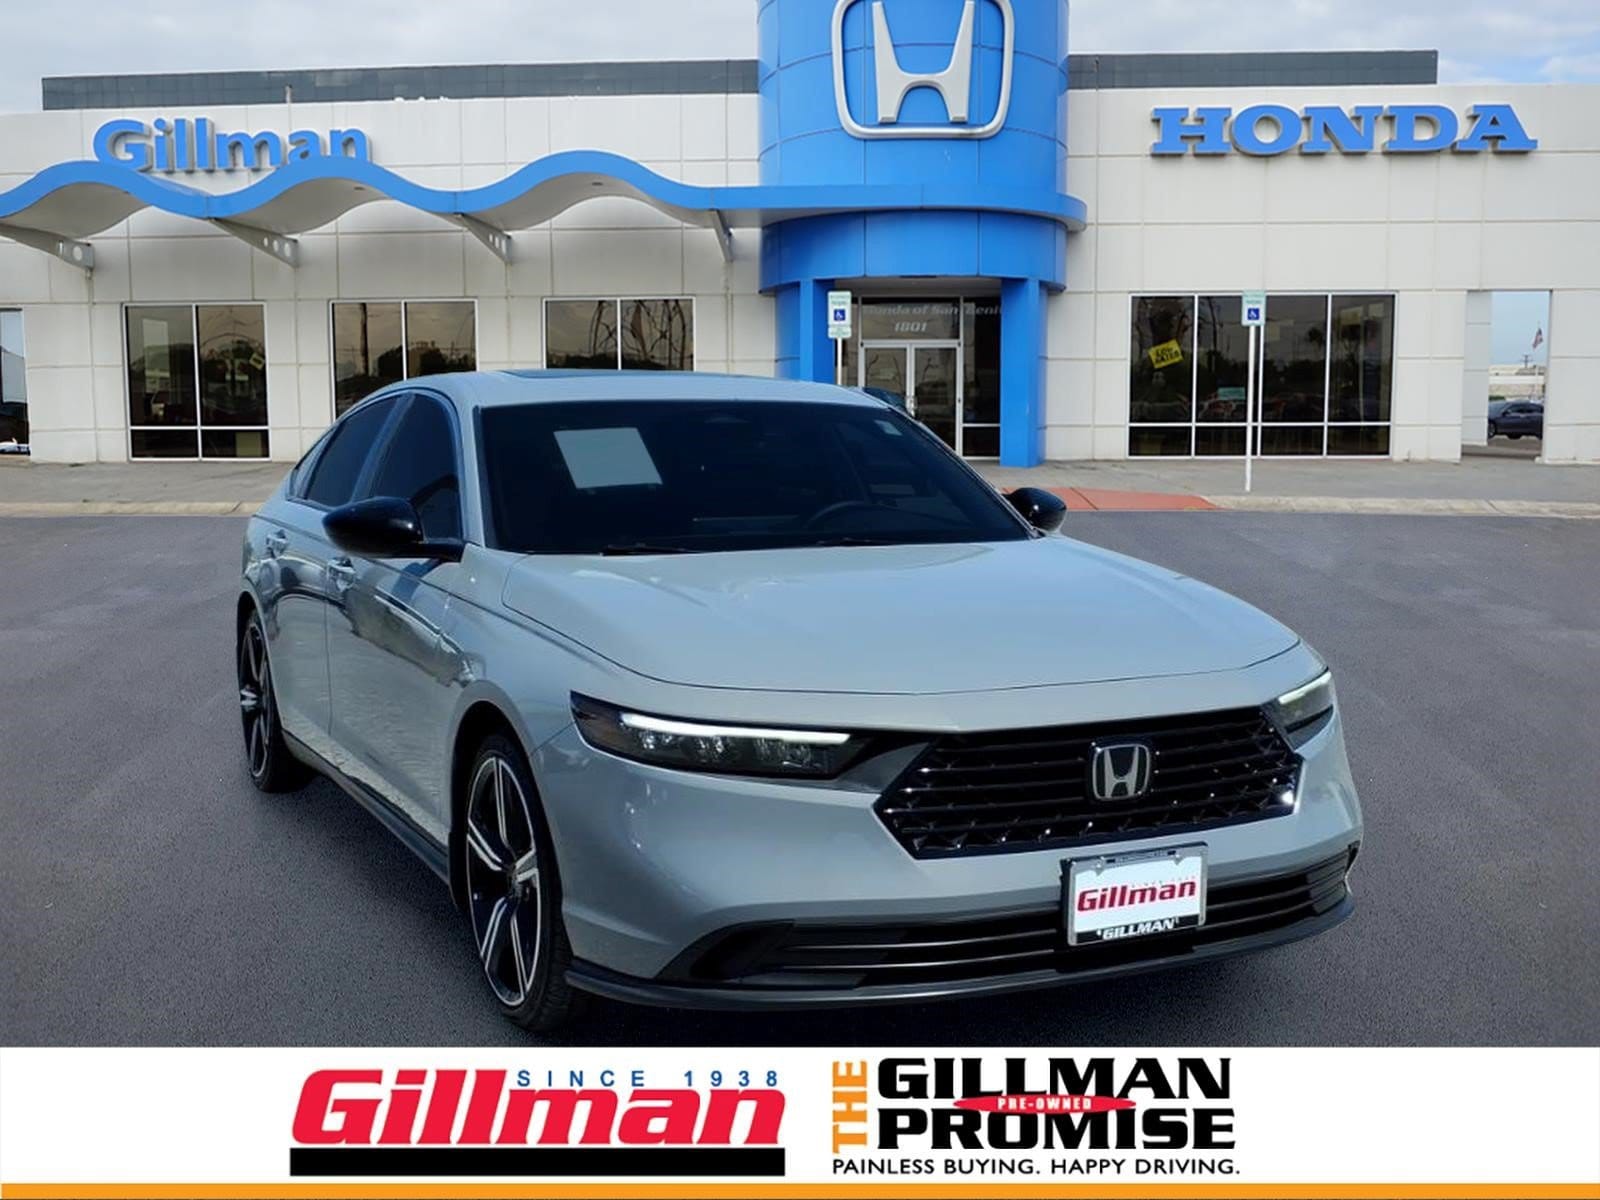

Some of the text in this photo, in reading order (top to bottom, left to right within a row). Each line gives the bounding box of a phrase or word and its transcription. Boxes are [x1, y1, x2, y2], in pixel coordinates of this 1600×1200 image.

[93, 117, 370, 171] Gillman
[1151, 104, 1538, 156] HONDA
[1077, 880, 1196, 912] Gillman
[1103, 918, 1175, 940] GILLMAN
